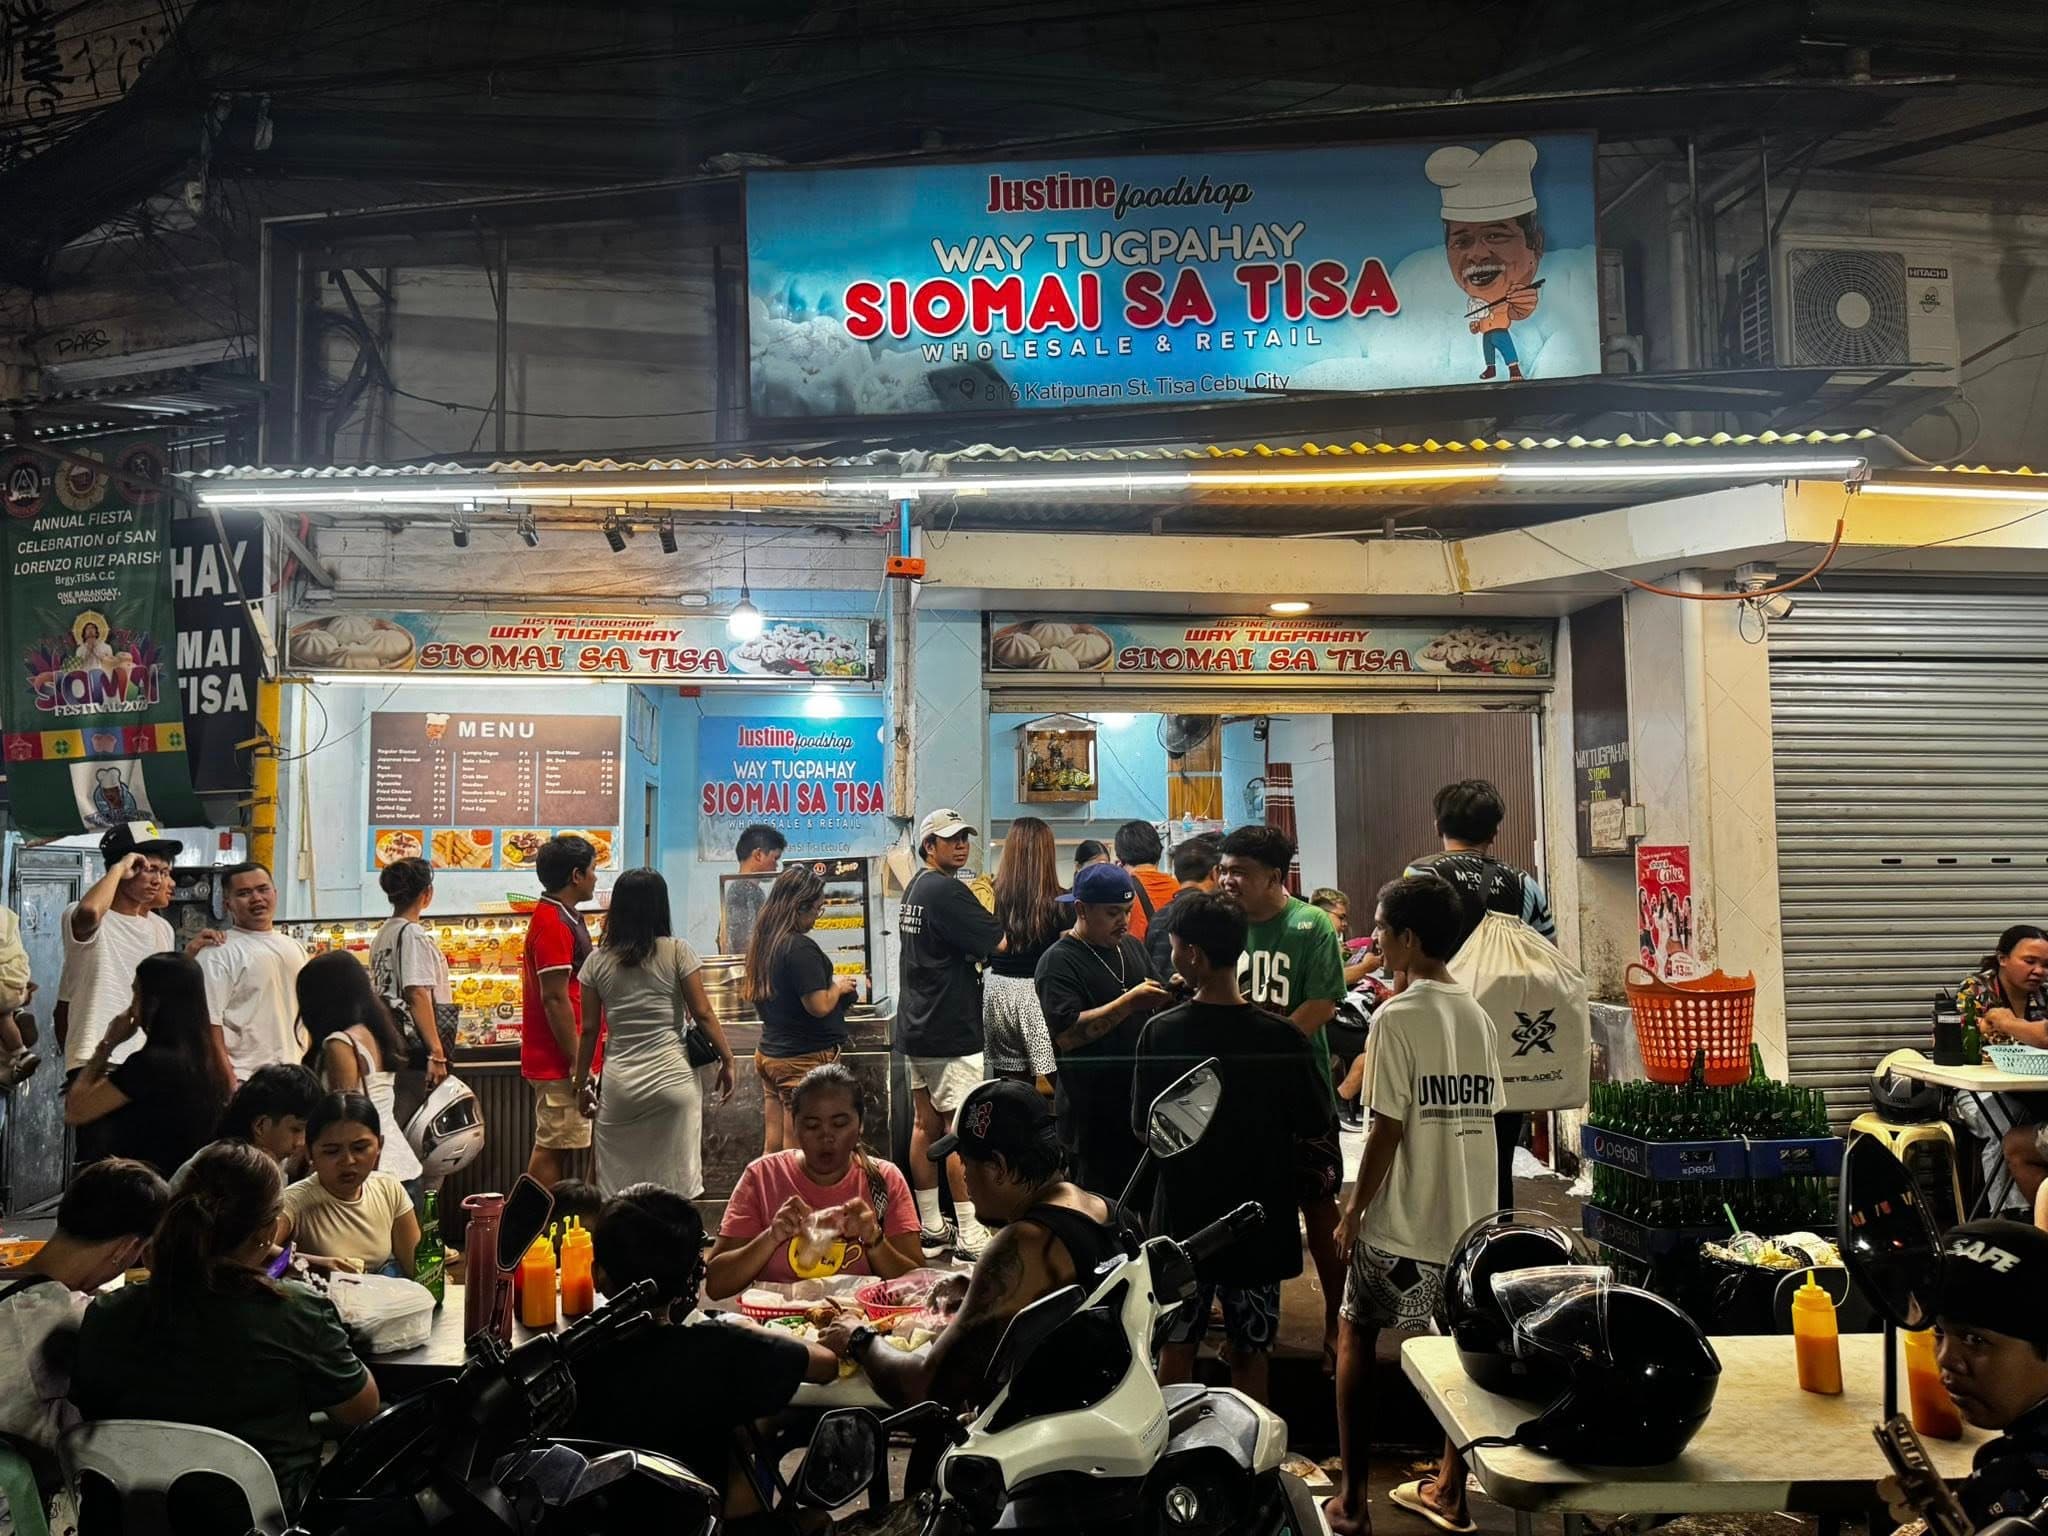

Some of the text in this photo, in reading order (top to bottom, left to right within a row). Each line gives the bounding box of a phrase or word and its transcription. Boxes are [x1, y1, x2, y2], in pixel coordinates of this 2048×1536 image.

[986, 172, 1254, 219] Justine foodshop
[931, 222, 1307, 274] WAY TUGPAHAY
[1909, 269, 1947, 278] HITACHI
[842, 256, 1402, 342] SIOMAI SA TISA
[921, 324, 1323, 363] WHOLESALE & RETAIL
[1025, 381, 1121, 401] Katipunan
[1126, 378, 1152, 396] St.
[1157, 376, 1195, 394] Tisa
[1199, 374, 1249, 392] Cebu
[1254, 371, 1290, 392] City
[32, 509, 133, 533] ANNUAL FIESTA
[17, 529, 156, 555] CELEBRATION of SAN
[14, 551, 162, 576] LORENZO RUIZ PARISH
[169, 540, 248, 599] HAY
[57, 592, 73, 600] ONE
[488, 625, 685, 643] WAY TUGPAHAY
[521, 617, 655, 628] JUSTINE FOODSHOP
[1215, 619, 1269, 628] JUSTINE
[1183, 628, 1371, 643] WAY TUGPAHAY
[176, 627, 241, 670] MAI
[419, 643, 729, 674] SIOMAI SA TISA
[1117, 646, 1415, 674] SIOMAI SA TISA
[54, 702, 122, 717] FESTIVAL
[458, 721, 535, 738] MENU
[737, 725, 854, 754] Justine foodshop
[732, 760, 857, 780] WAY TUGPAHAY
[702, 780, 885, 816] SIOMAI SA TISA
[819, 818, 861, 830] RETAIL
[1657, 864, 1684, 883] Coke
[1605, 1140, 1640, 1164] pepsi
[1687, 1163, 1716, 1176] pepsi
